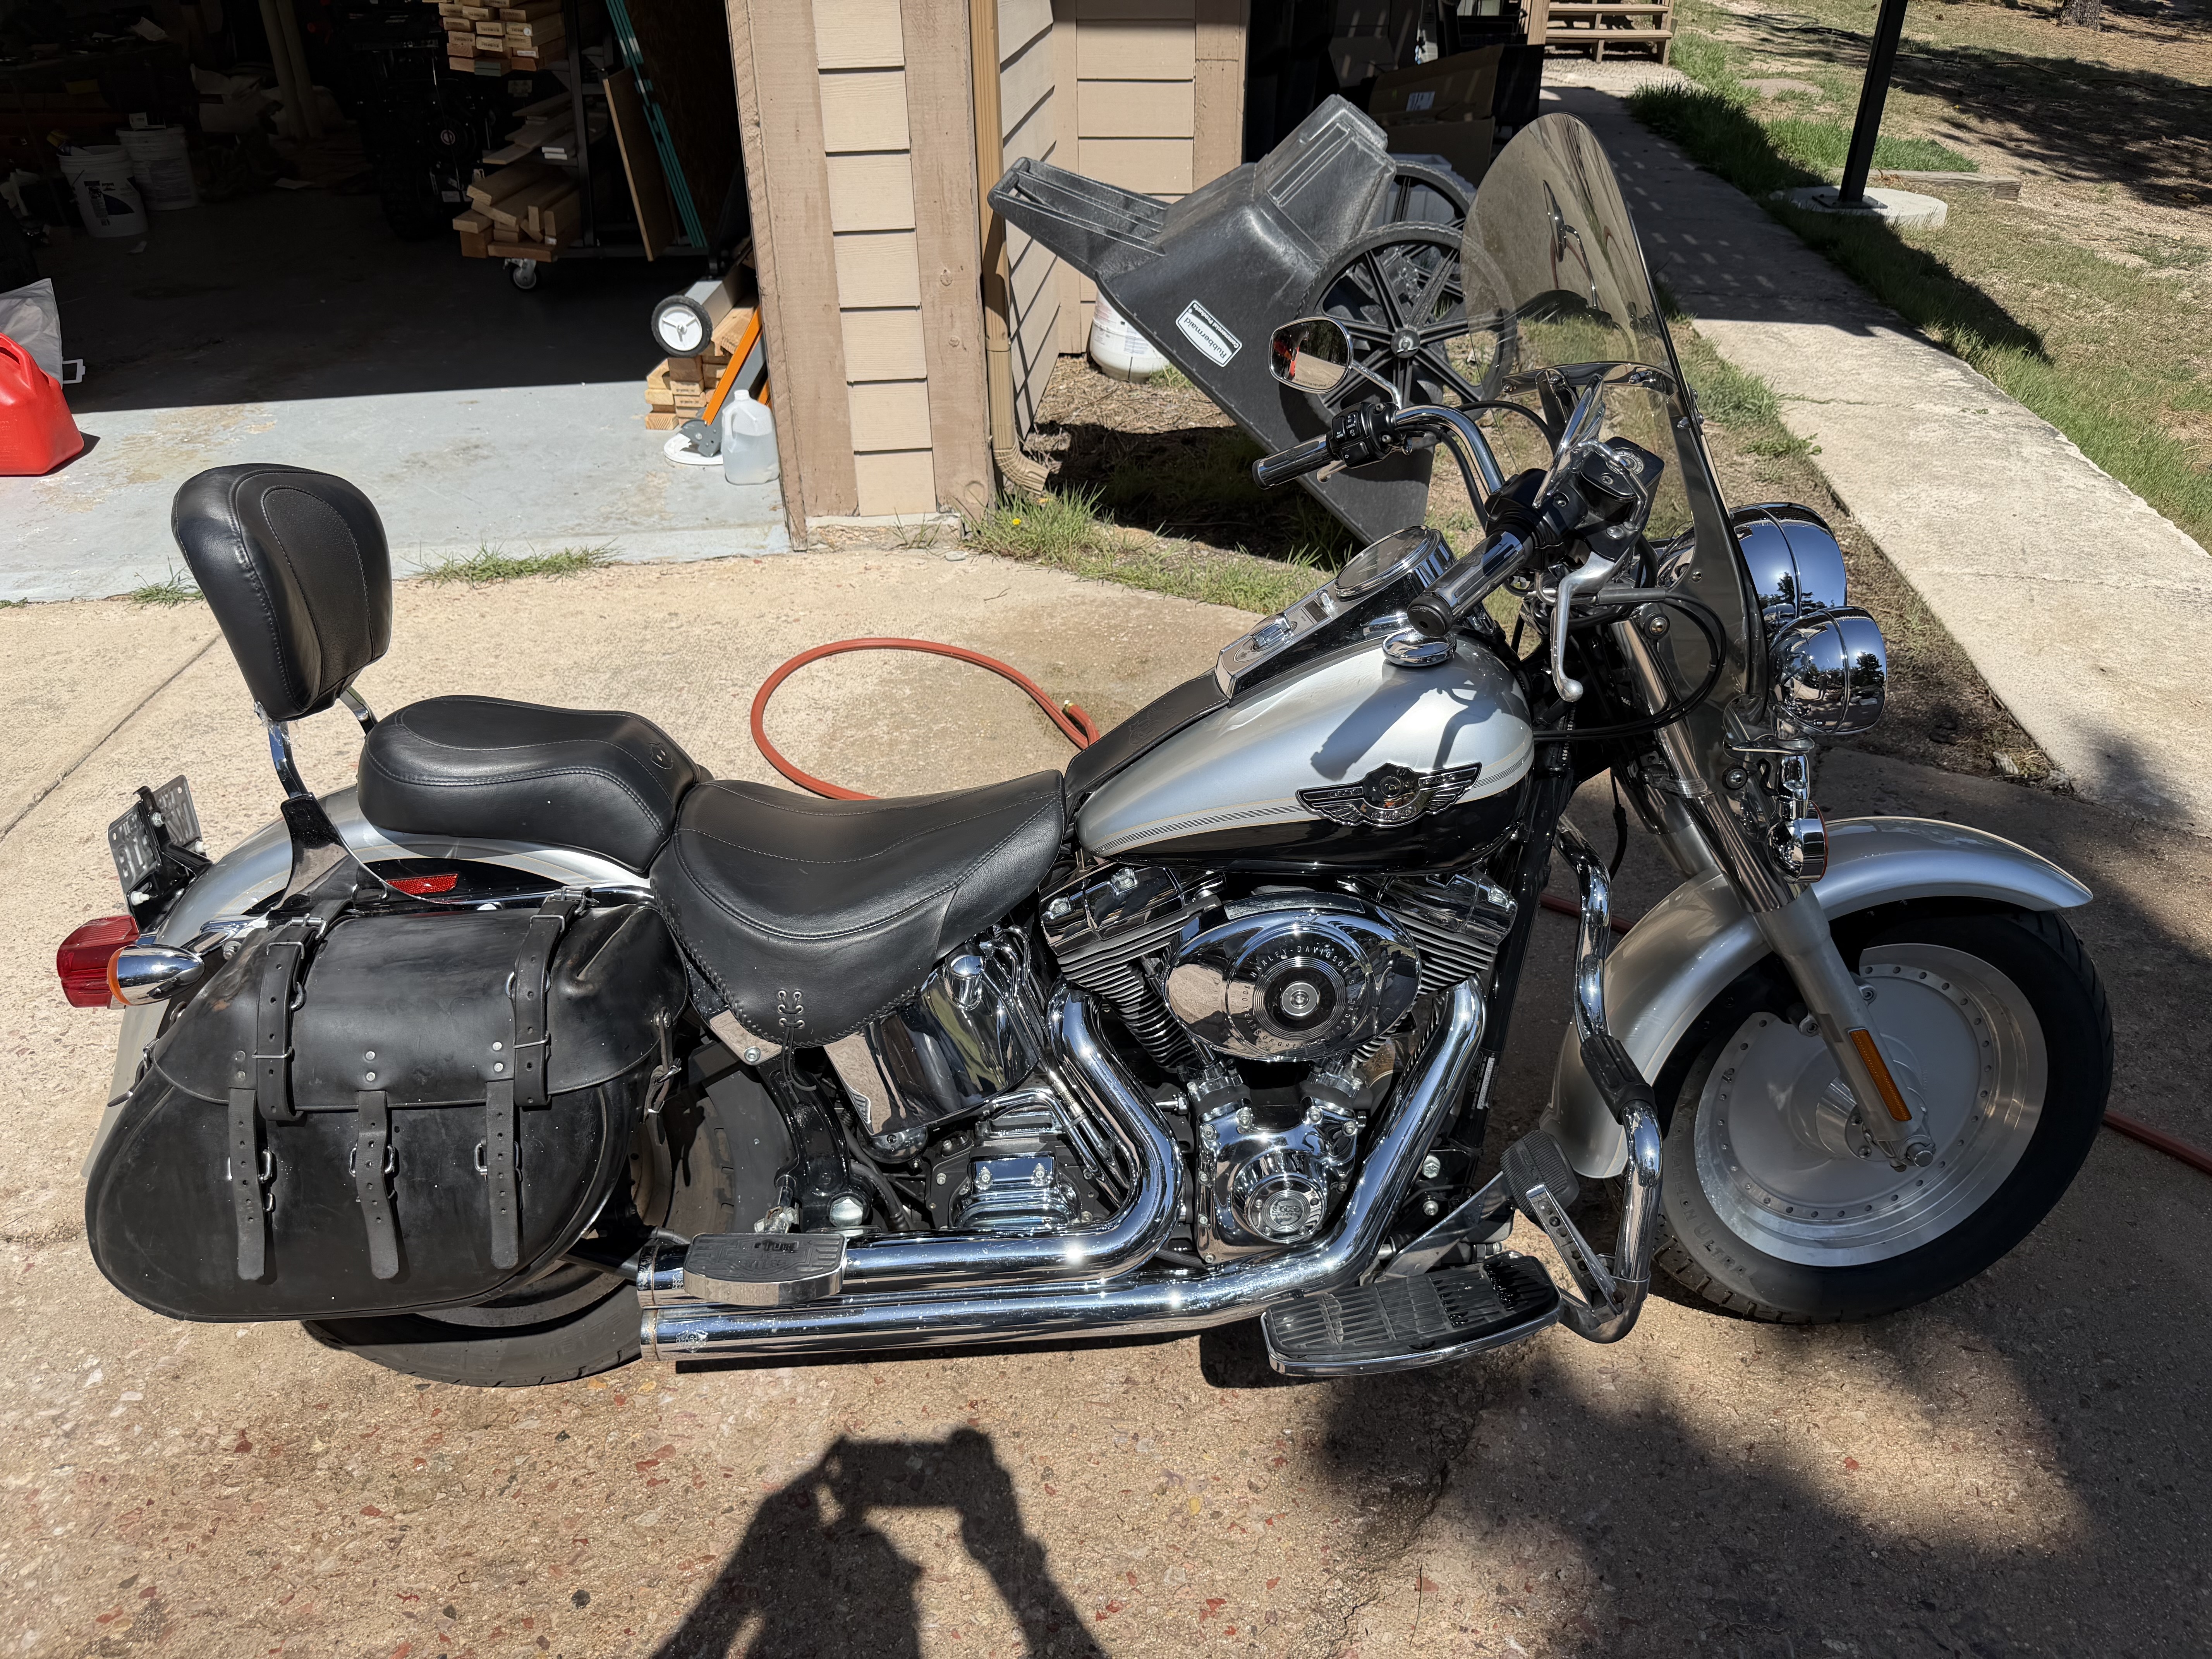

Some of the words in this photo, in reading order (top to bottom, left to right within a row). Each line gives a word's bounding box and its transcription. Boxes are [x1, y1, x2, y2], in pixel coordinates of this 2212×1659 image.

[1192, 303, 1214, 325] Products
[1183, 317, 1227, 359] Rubbermaid
[1212, 322, 1240, 349] Commercial
[1250, 946, 1349, 977] HARLEY-DAVIDSON
[1694, 1222, 1747, 1277] ULTRA
